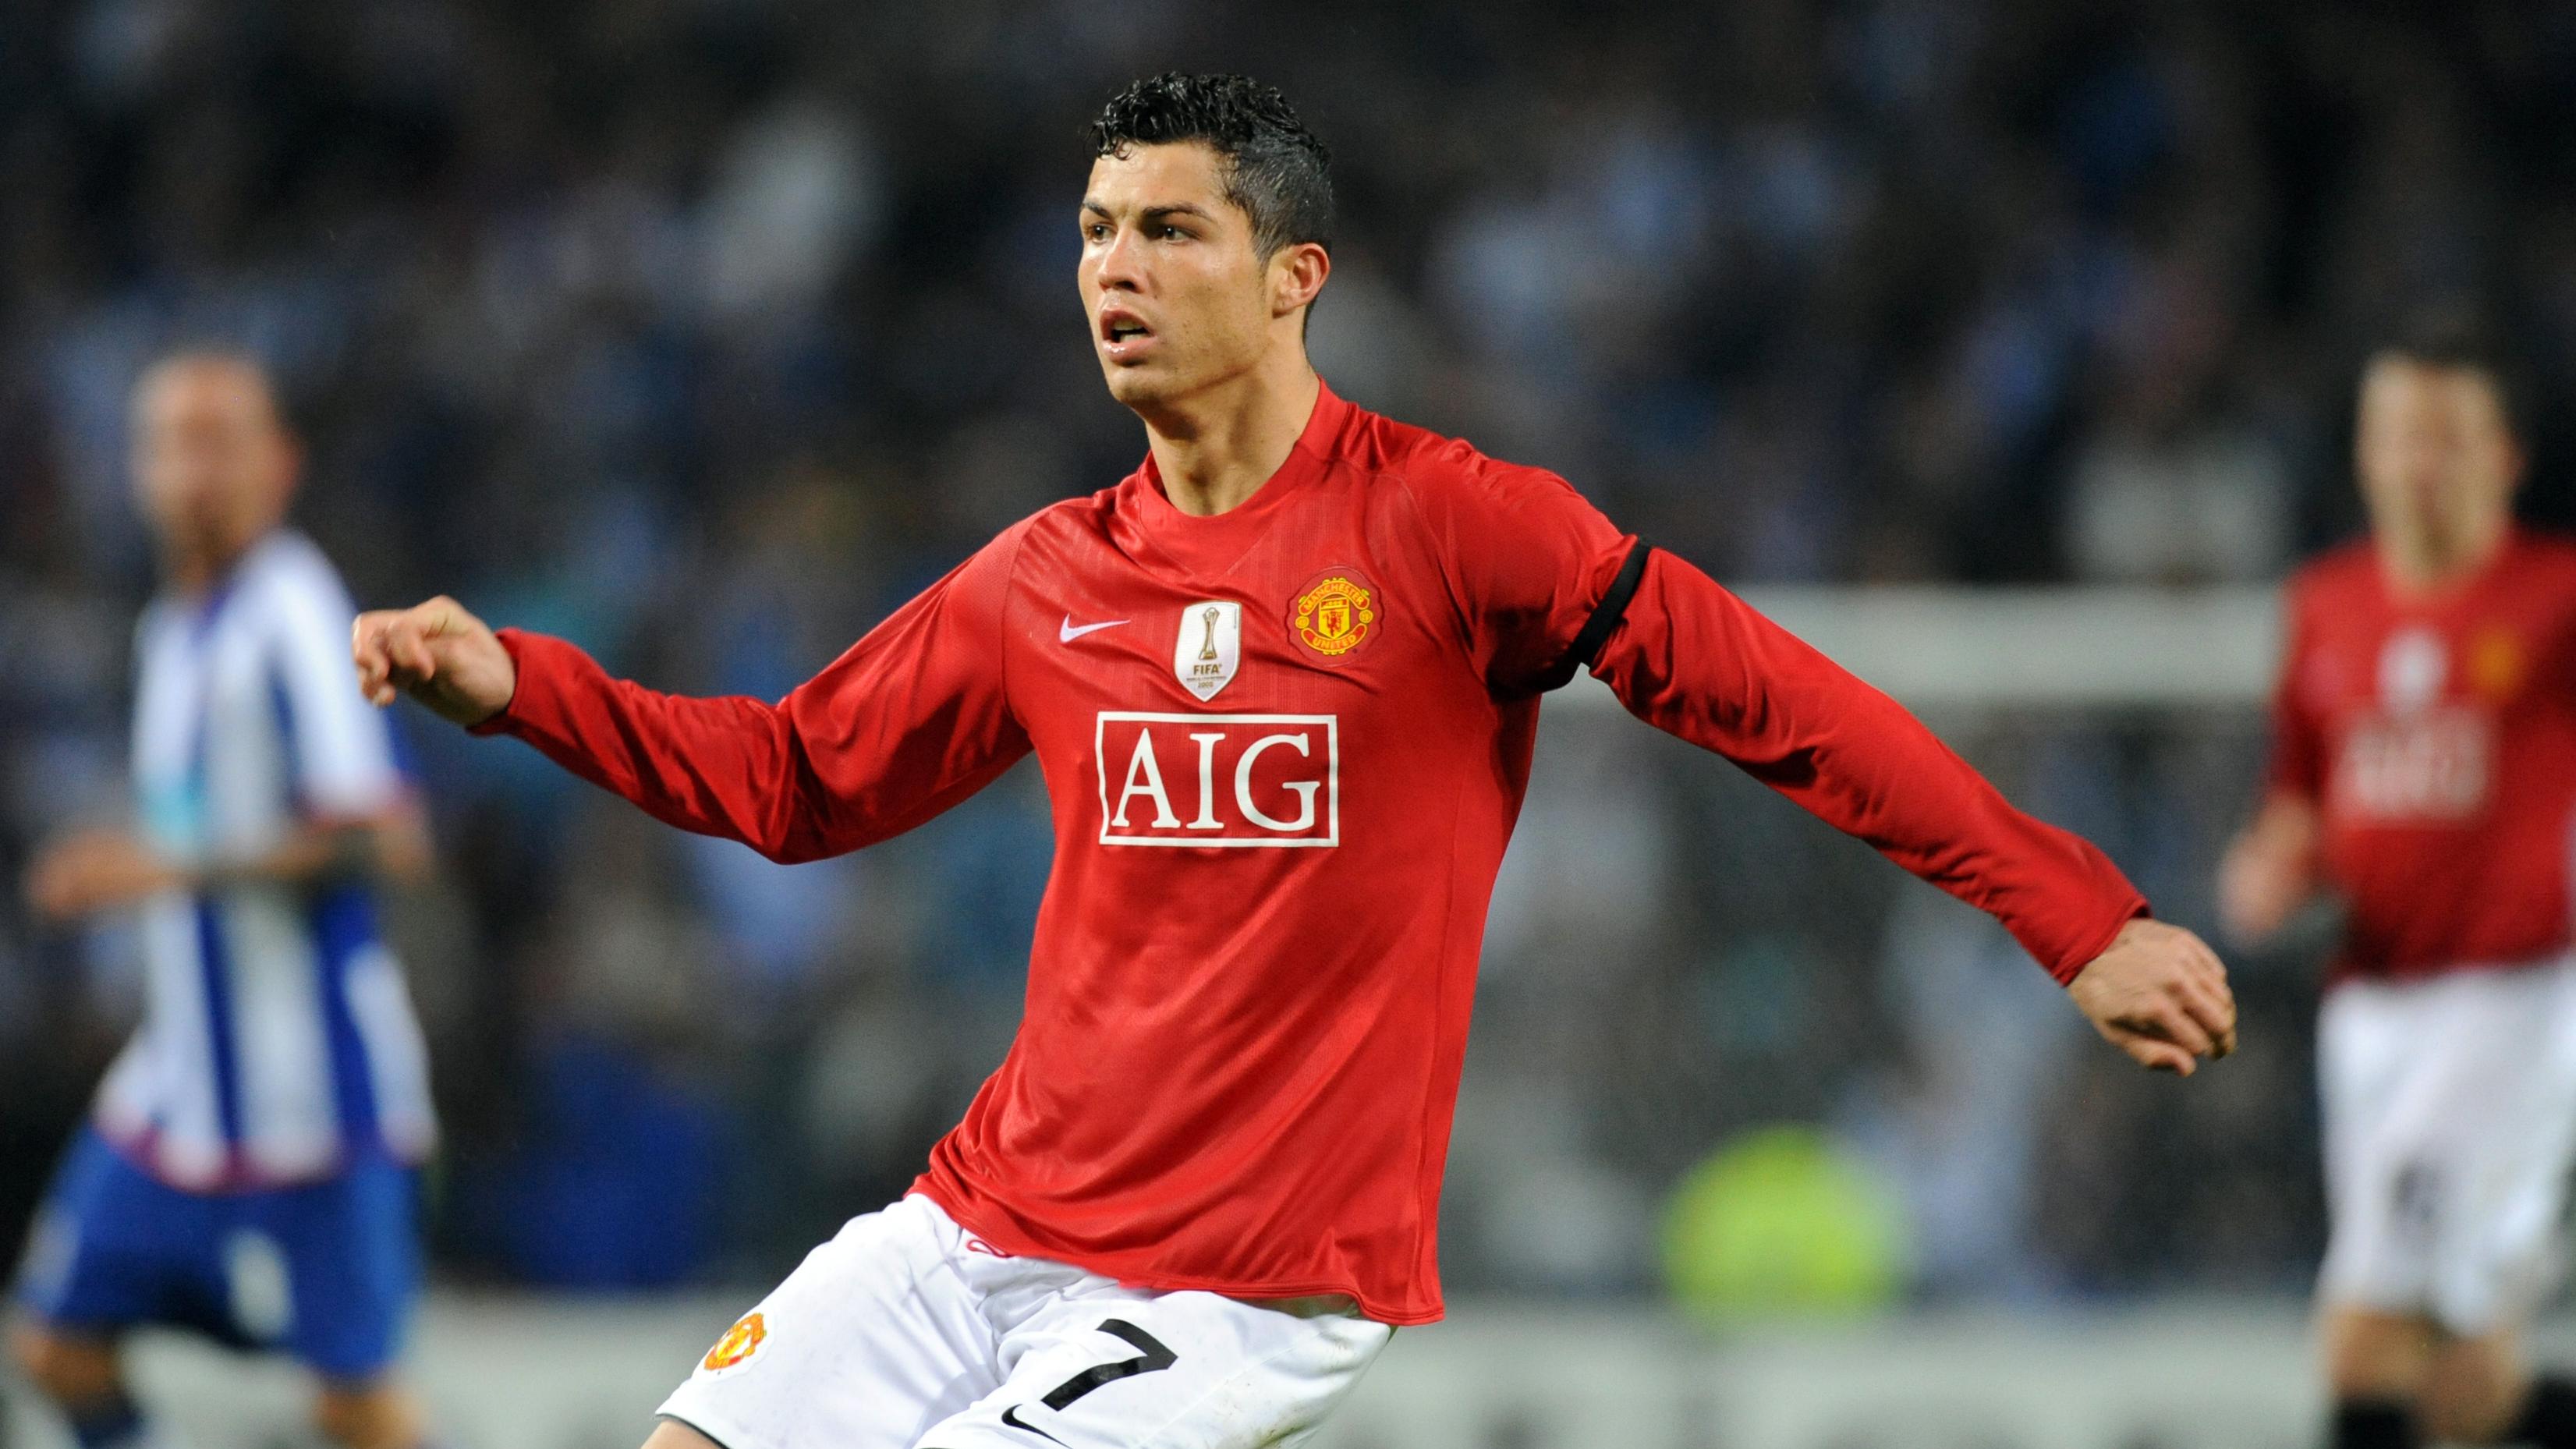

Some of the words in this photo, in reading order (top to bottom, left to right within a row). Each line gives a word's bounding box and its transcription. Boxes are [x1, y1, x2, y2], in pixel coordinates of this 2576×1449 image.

[1304, 583, 1364, 608] MANCHESTER
[1312, 634, 1356, 649] UNITED
[1193, 664, 1220, 675] FIFA
[1111, 727, 1320, 831] AIG
[1040, 1318, 1178, 1412] 7
